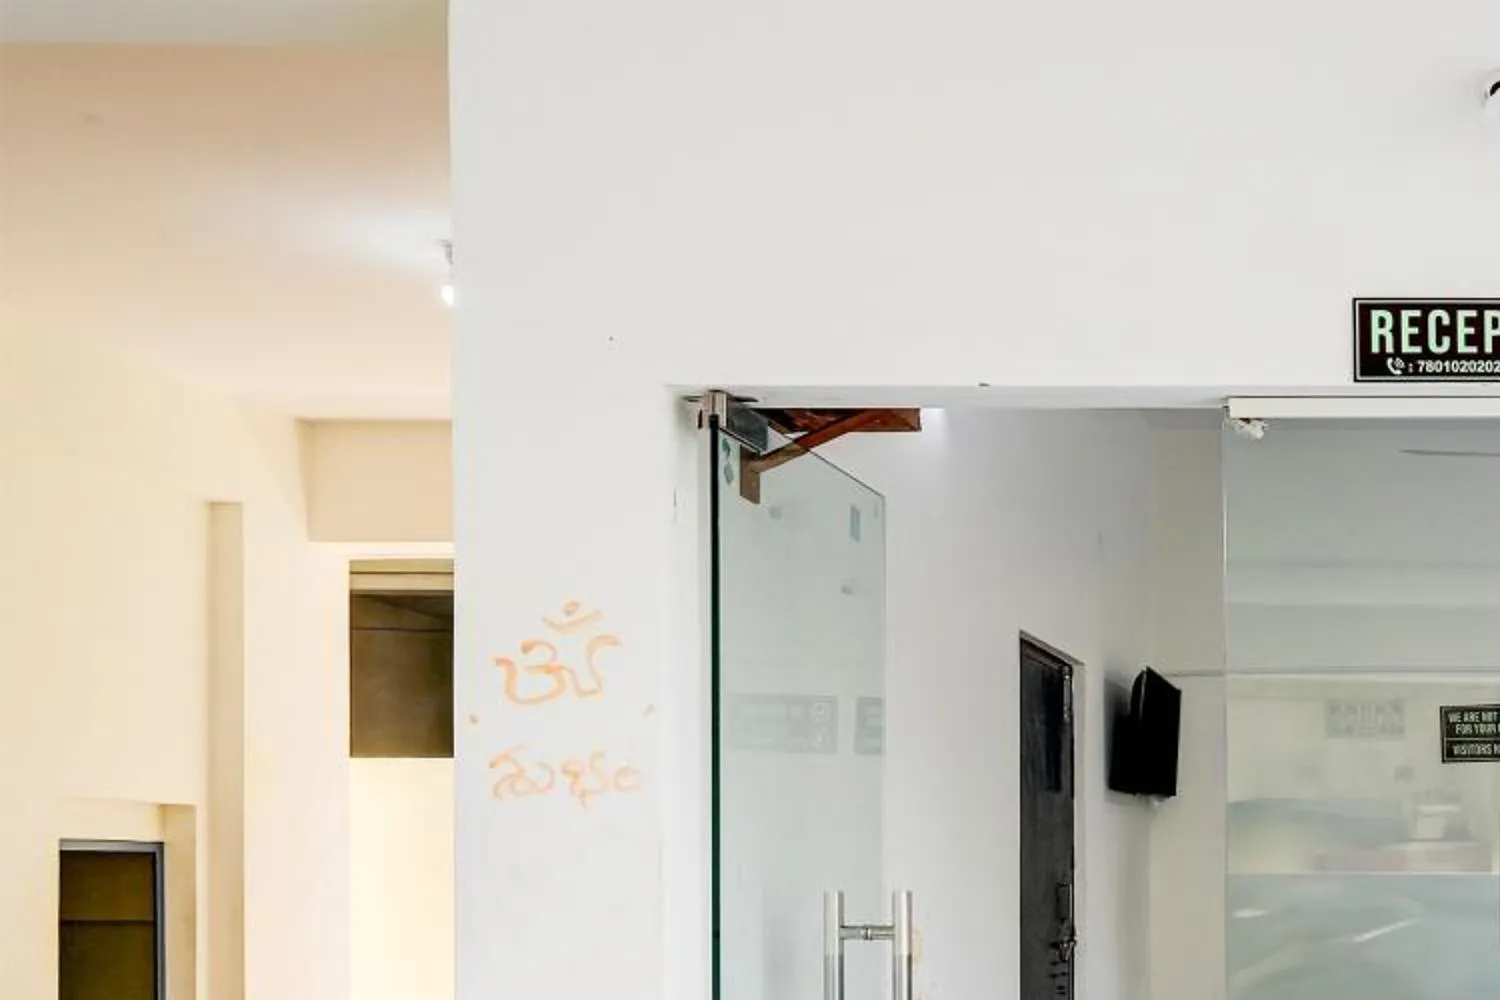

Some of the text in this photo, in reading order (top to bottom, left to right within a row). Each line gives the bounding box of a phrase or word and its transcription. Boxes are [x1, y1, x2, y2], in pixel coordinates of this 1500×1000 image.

[1448, 711, 1462, 723] WE
[1464, 711, 1480, 722] ARE
[1456, 723, 1473, 734] FOR
[1474, 723, 1497, 734] YOUR
[1453, 743, 1492, 755] VISITORS
